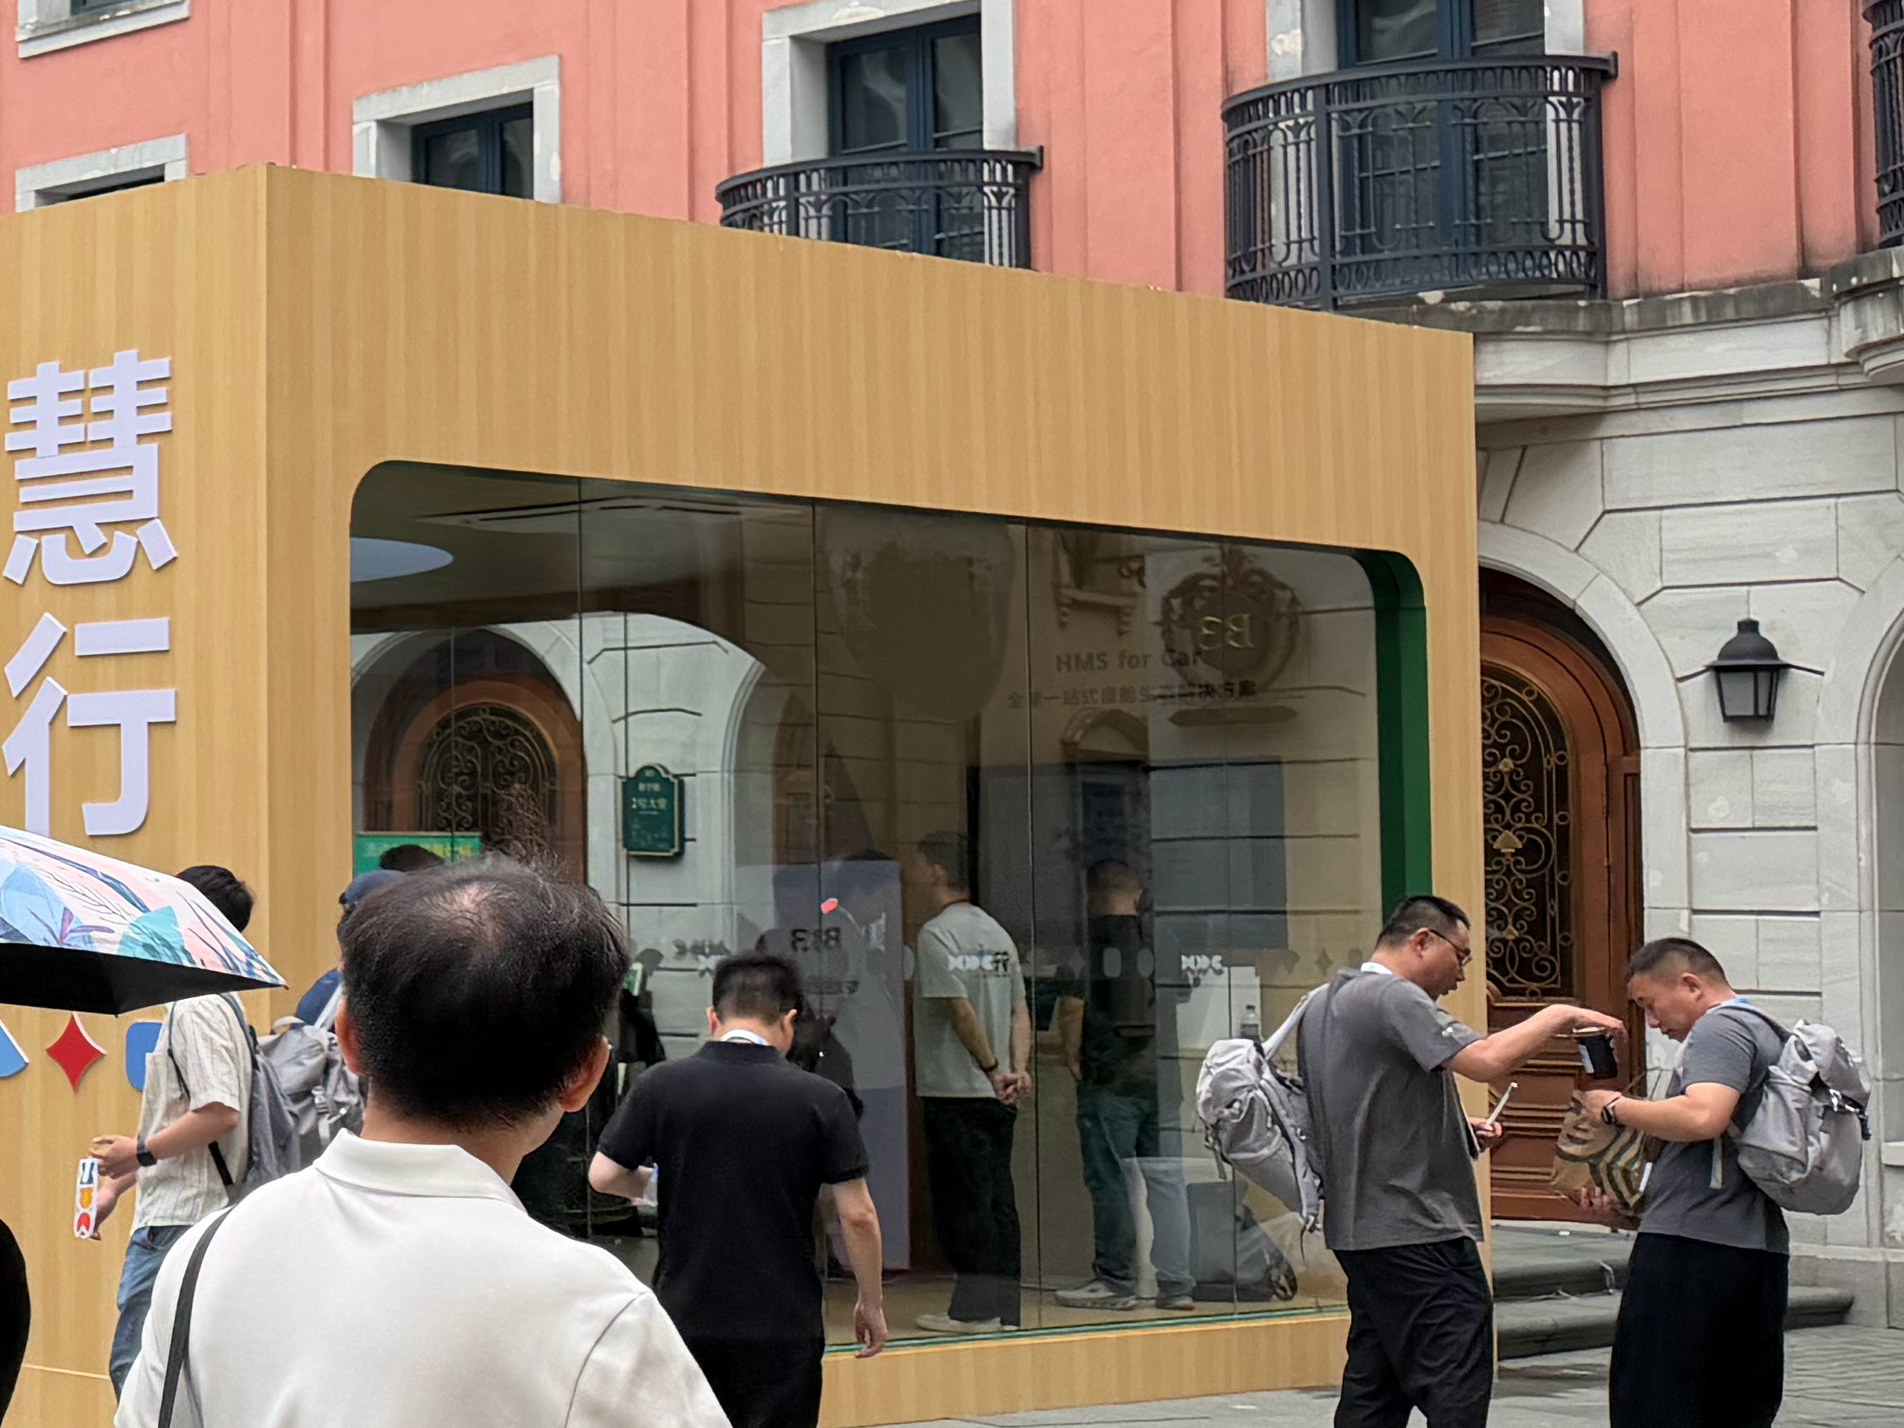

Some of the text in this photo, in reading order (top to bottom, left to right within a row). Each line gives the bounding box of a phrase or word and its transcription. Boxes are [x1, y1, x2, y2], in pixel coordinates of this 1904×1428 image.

[1055, 648, 1202, 673] HMS for Car
